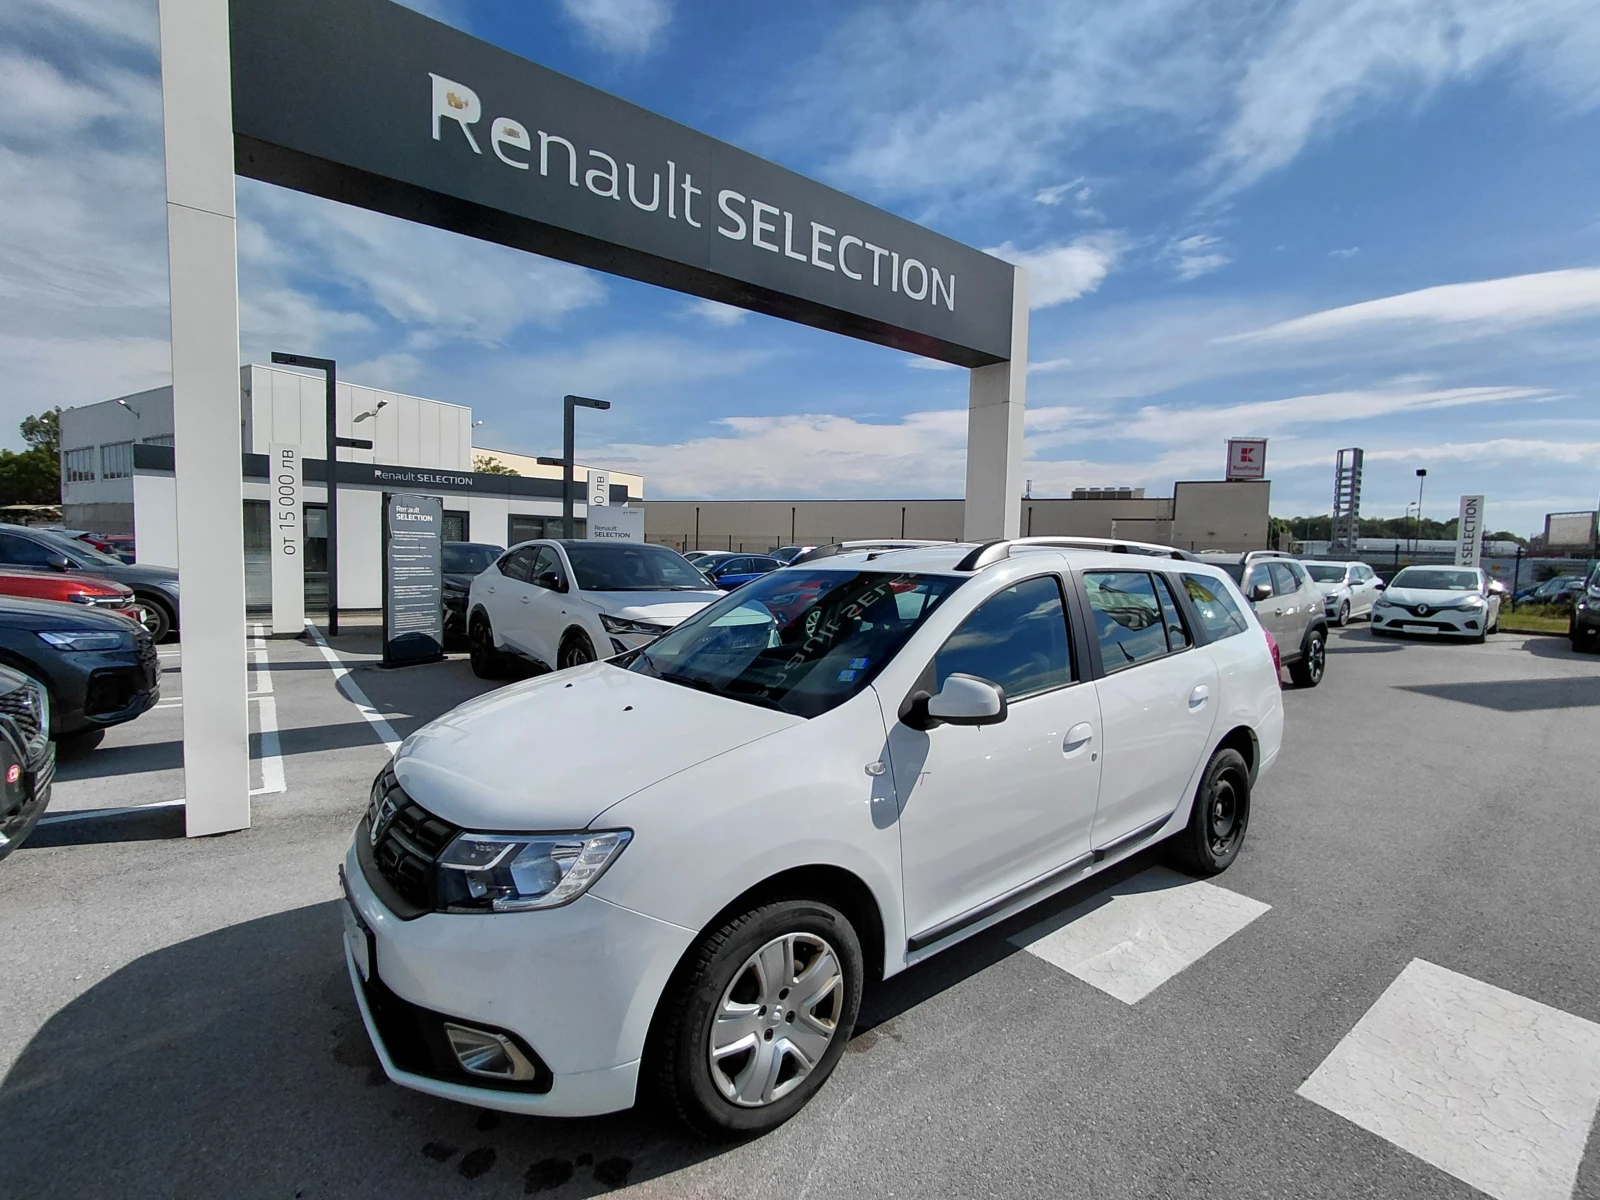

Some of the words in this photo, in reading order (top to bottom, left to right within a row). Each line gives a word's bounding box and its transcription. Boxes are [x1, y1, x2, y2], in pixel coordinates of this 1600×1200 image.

[428, 72, 702, 228] Renault
[717, 189, 956, 312] SELECTION
[278, 474, 295, 507] 000
[374, 469, 416, 482] Renault
[417, 473, 473, 486] SELECTION
[279, 512, 296, 531] 15
[1461, 498, 1478, 558] SELECTION
